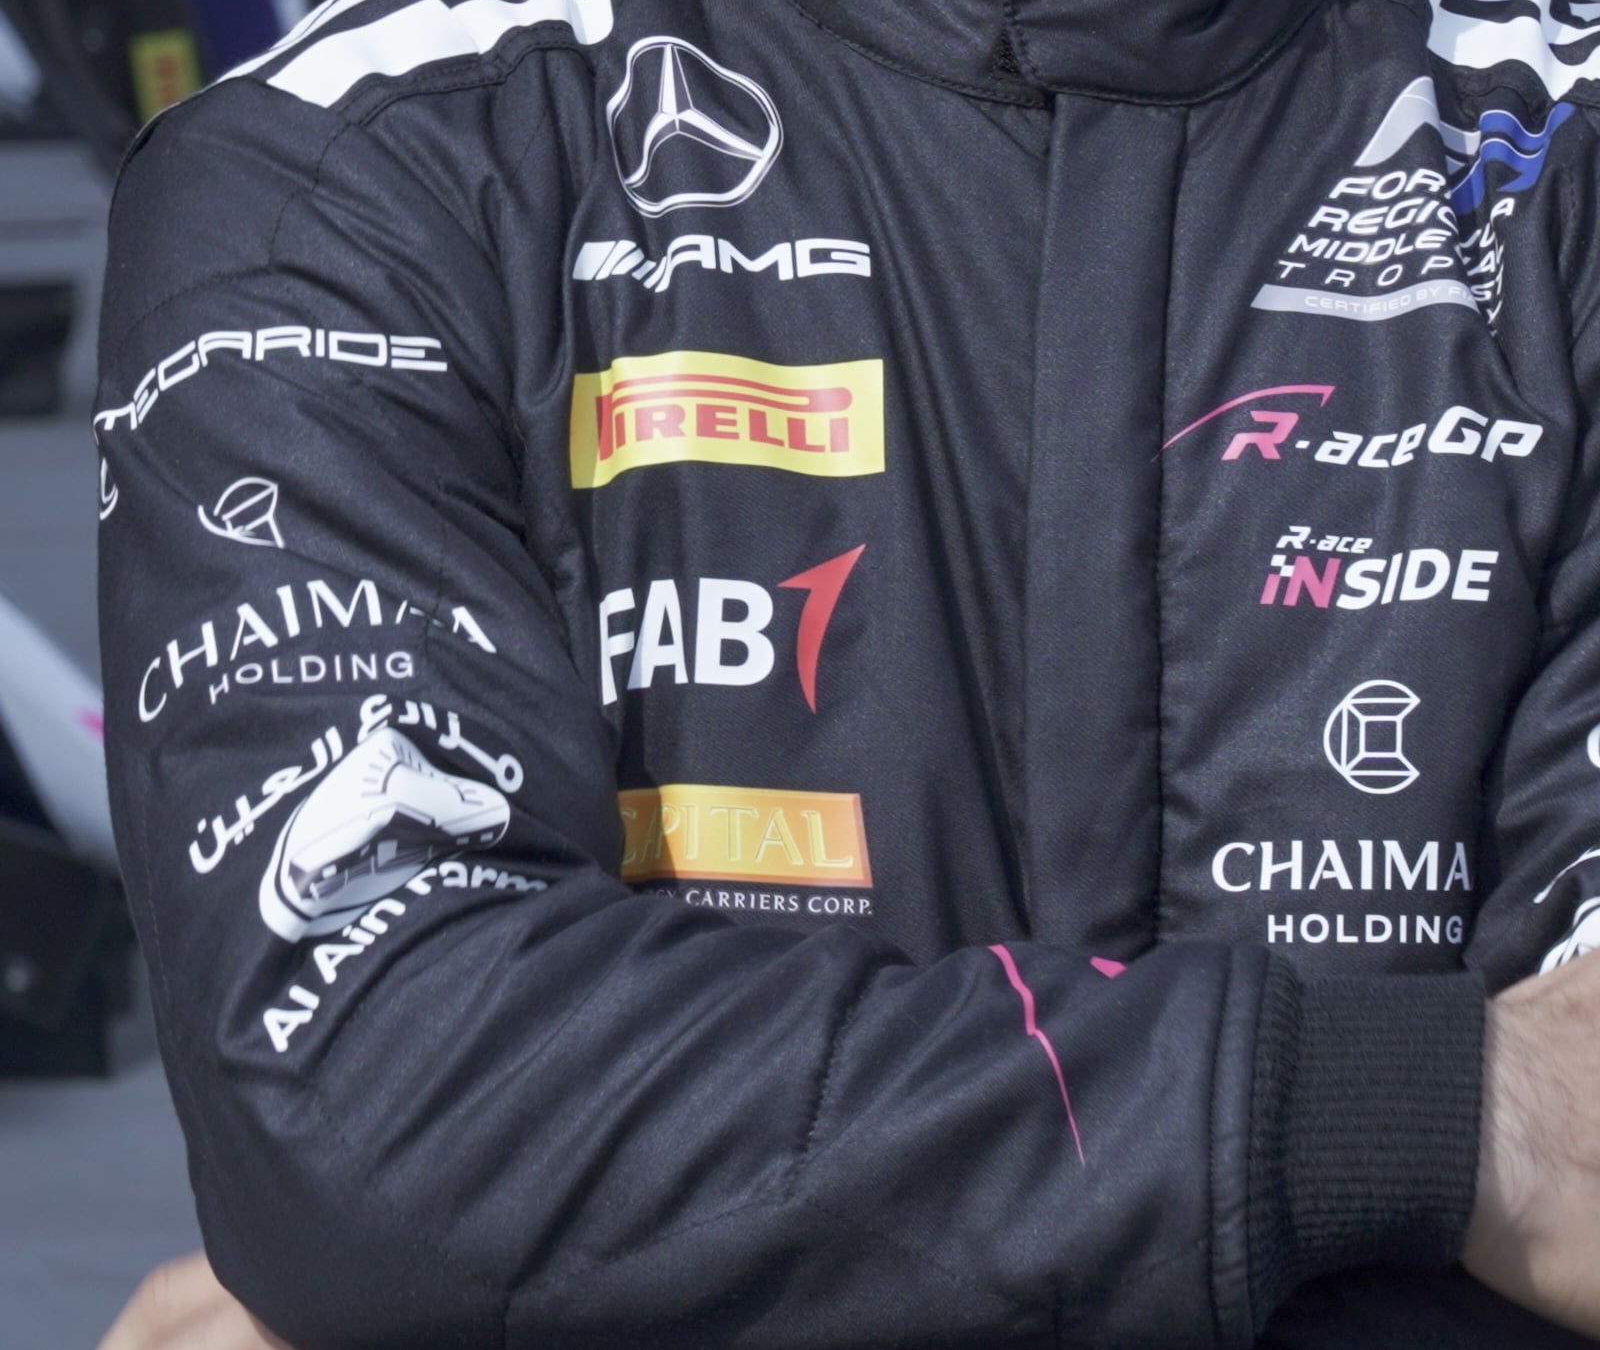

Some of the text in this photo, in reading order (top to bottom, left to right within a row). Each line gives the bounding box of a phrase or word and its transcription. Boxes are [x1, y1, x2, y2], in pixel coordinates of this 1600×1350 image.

[1287, 229, 1452, 264] MIDDLE
[1304, 293, 1411, 314] CERTIFIED
[1415, 286, 1441, 301] BY
[93, 325, 448, 446] MEGARIDE
[596, 373, 853, 461] PIRELLI
[210, 651, 414, 705] HOLDING
[685, 888, 800, 912] CARRIERS
[807, 895, 874, 916] CORP.
[1267, 914, 1463, 944] HOLDING
[263, 985, 320, 1052] Al
[313, 897, 406, 984] Ain
